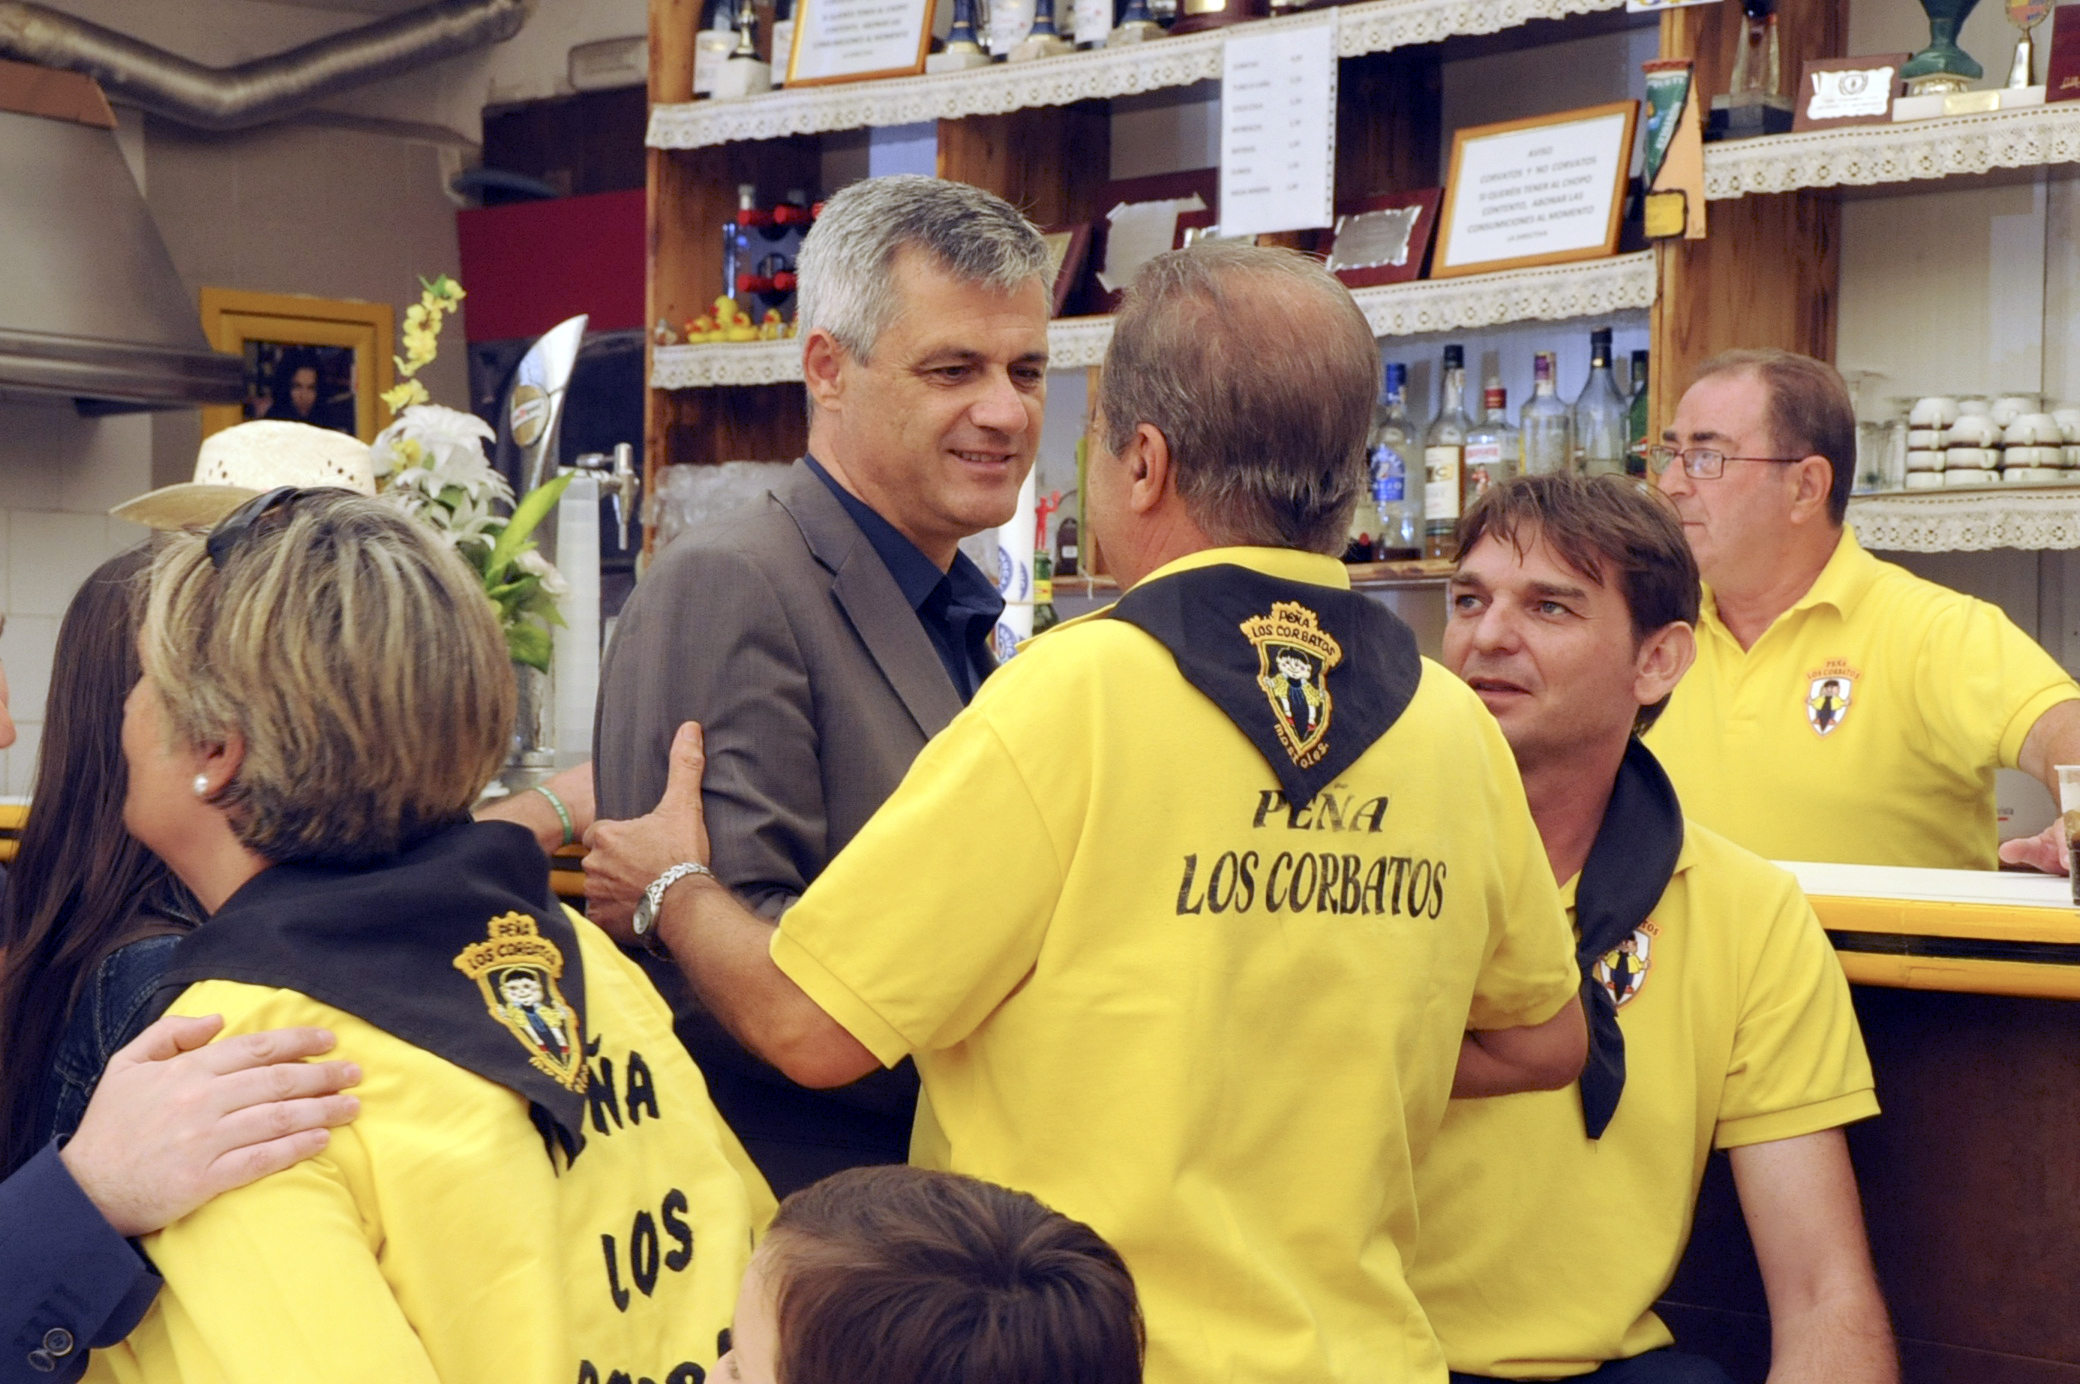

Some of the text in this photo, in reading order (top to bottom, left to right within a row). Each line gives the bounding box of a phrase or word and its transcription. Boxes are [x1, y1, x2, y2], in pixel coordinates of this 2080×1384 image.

[1251, 624, 1336, 656] LOS CORBATOS
[1252, 783, 1389, 832] PEÑA
[1175, 851, 1448, 920] LOS CORBATOS
[586, 1033, 661, 1137] ÑA
[600, 1187, 694, 1314] LOS
